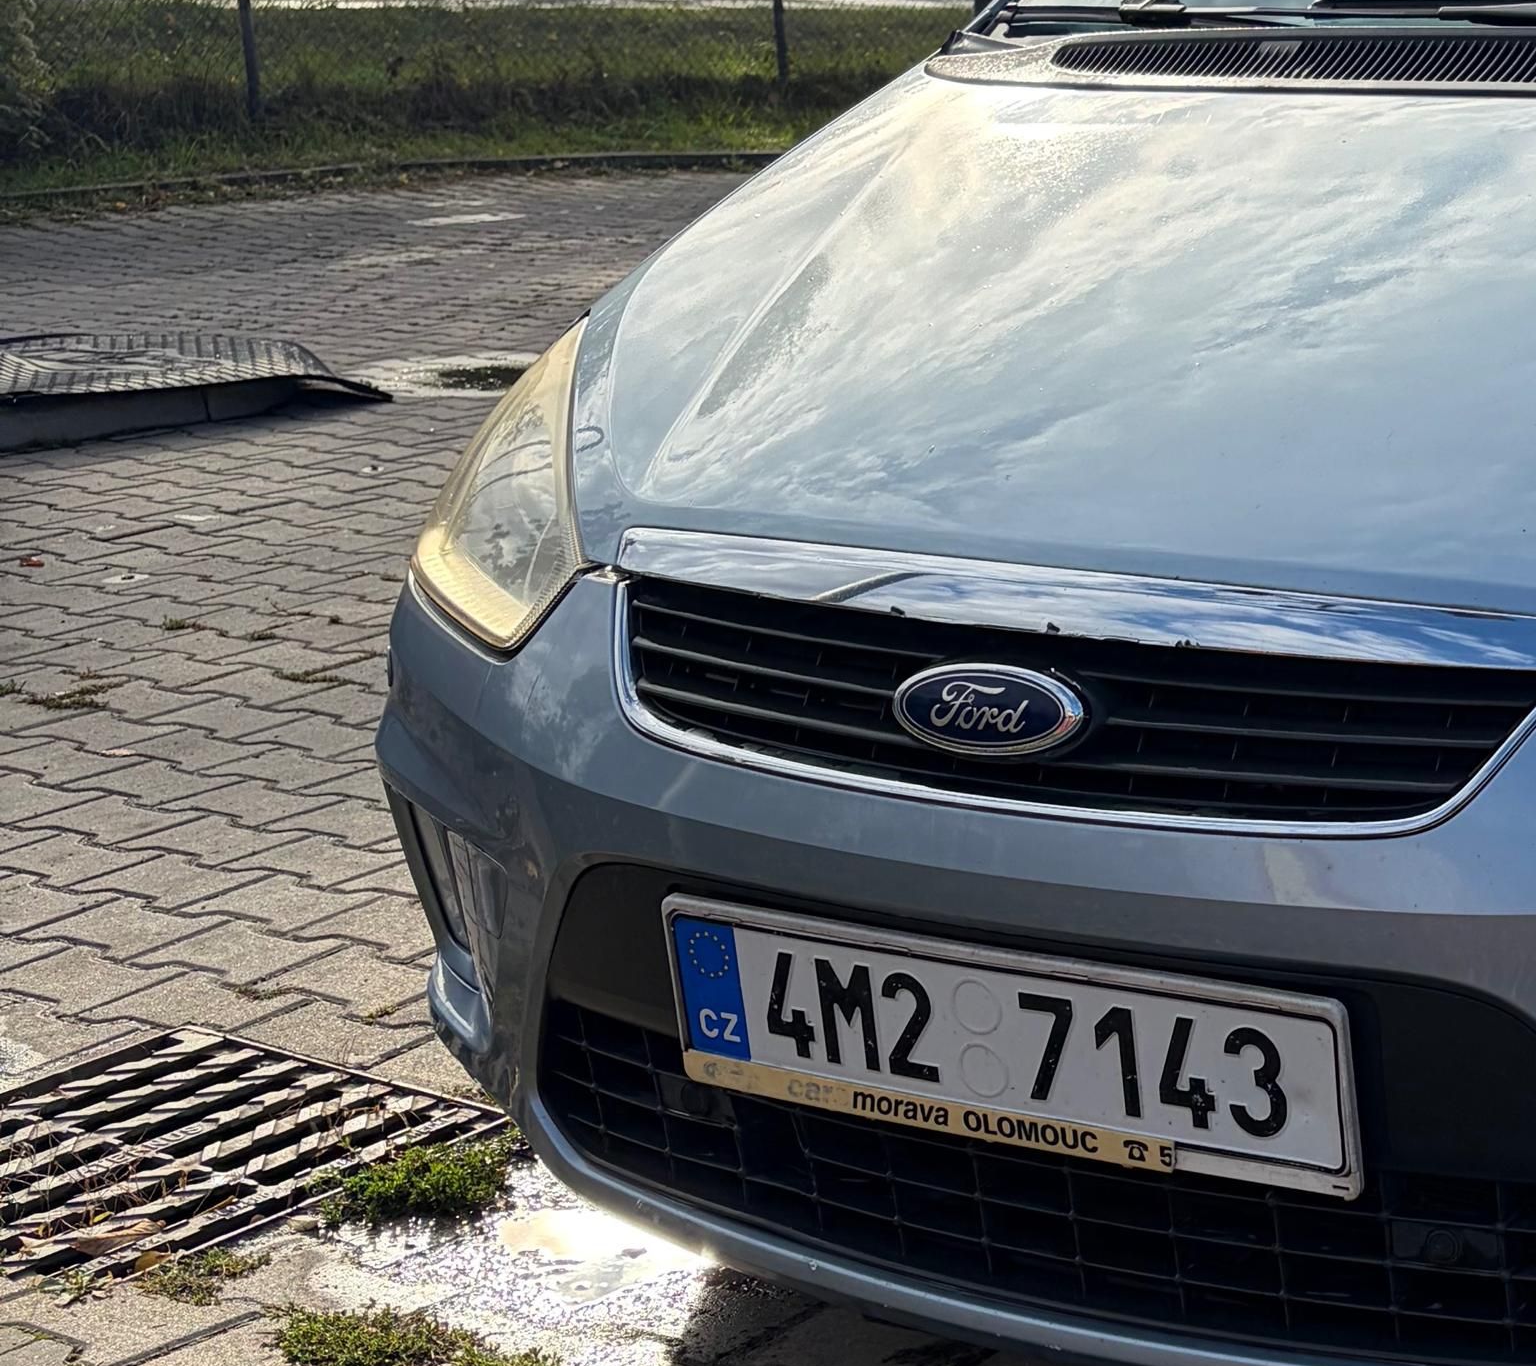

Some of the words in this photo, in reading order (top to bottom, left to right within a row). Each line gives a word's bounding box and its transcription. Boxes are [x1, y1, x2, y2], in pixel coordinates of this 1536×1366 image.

[930, 681, 1029, 733] Ford
[699, 1008, 741, 1043] CZ
[767, 951, 940, 1083] 4M2
[1018, 991, 1287, 1137] 7143
[853, 1091, 949, 1126] morava
[963, 1110, 1098, 1154] OLOMOUC
